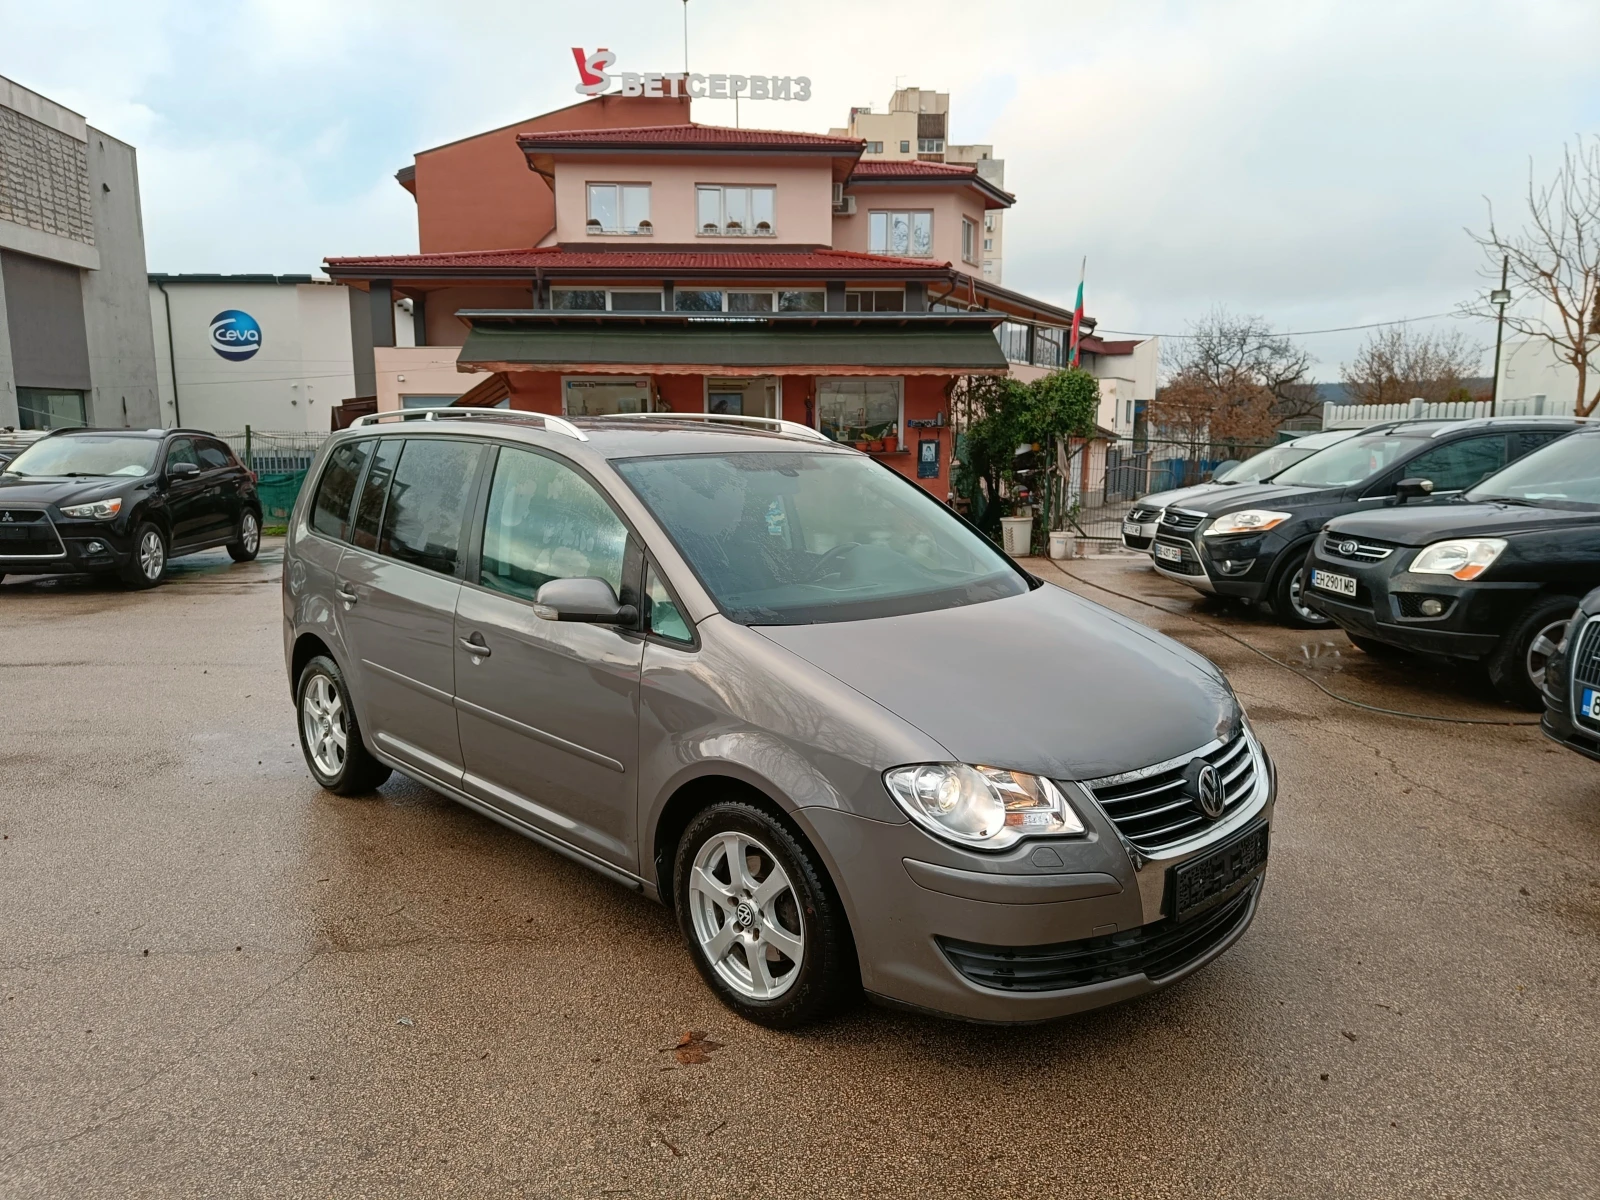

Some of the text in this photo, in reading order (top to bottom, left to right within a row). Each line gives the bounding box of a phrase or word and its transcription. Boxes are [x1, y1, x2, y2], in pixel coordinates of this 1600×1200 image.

[621, 72, 812, 102] ВЕТСЕРВИЗ
[1316, 572, 1355, 593] EH 2901 MB
